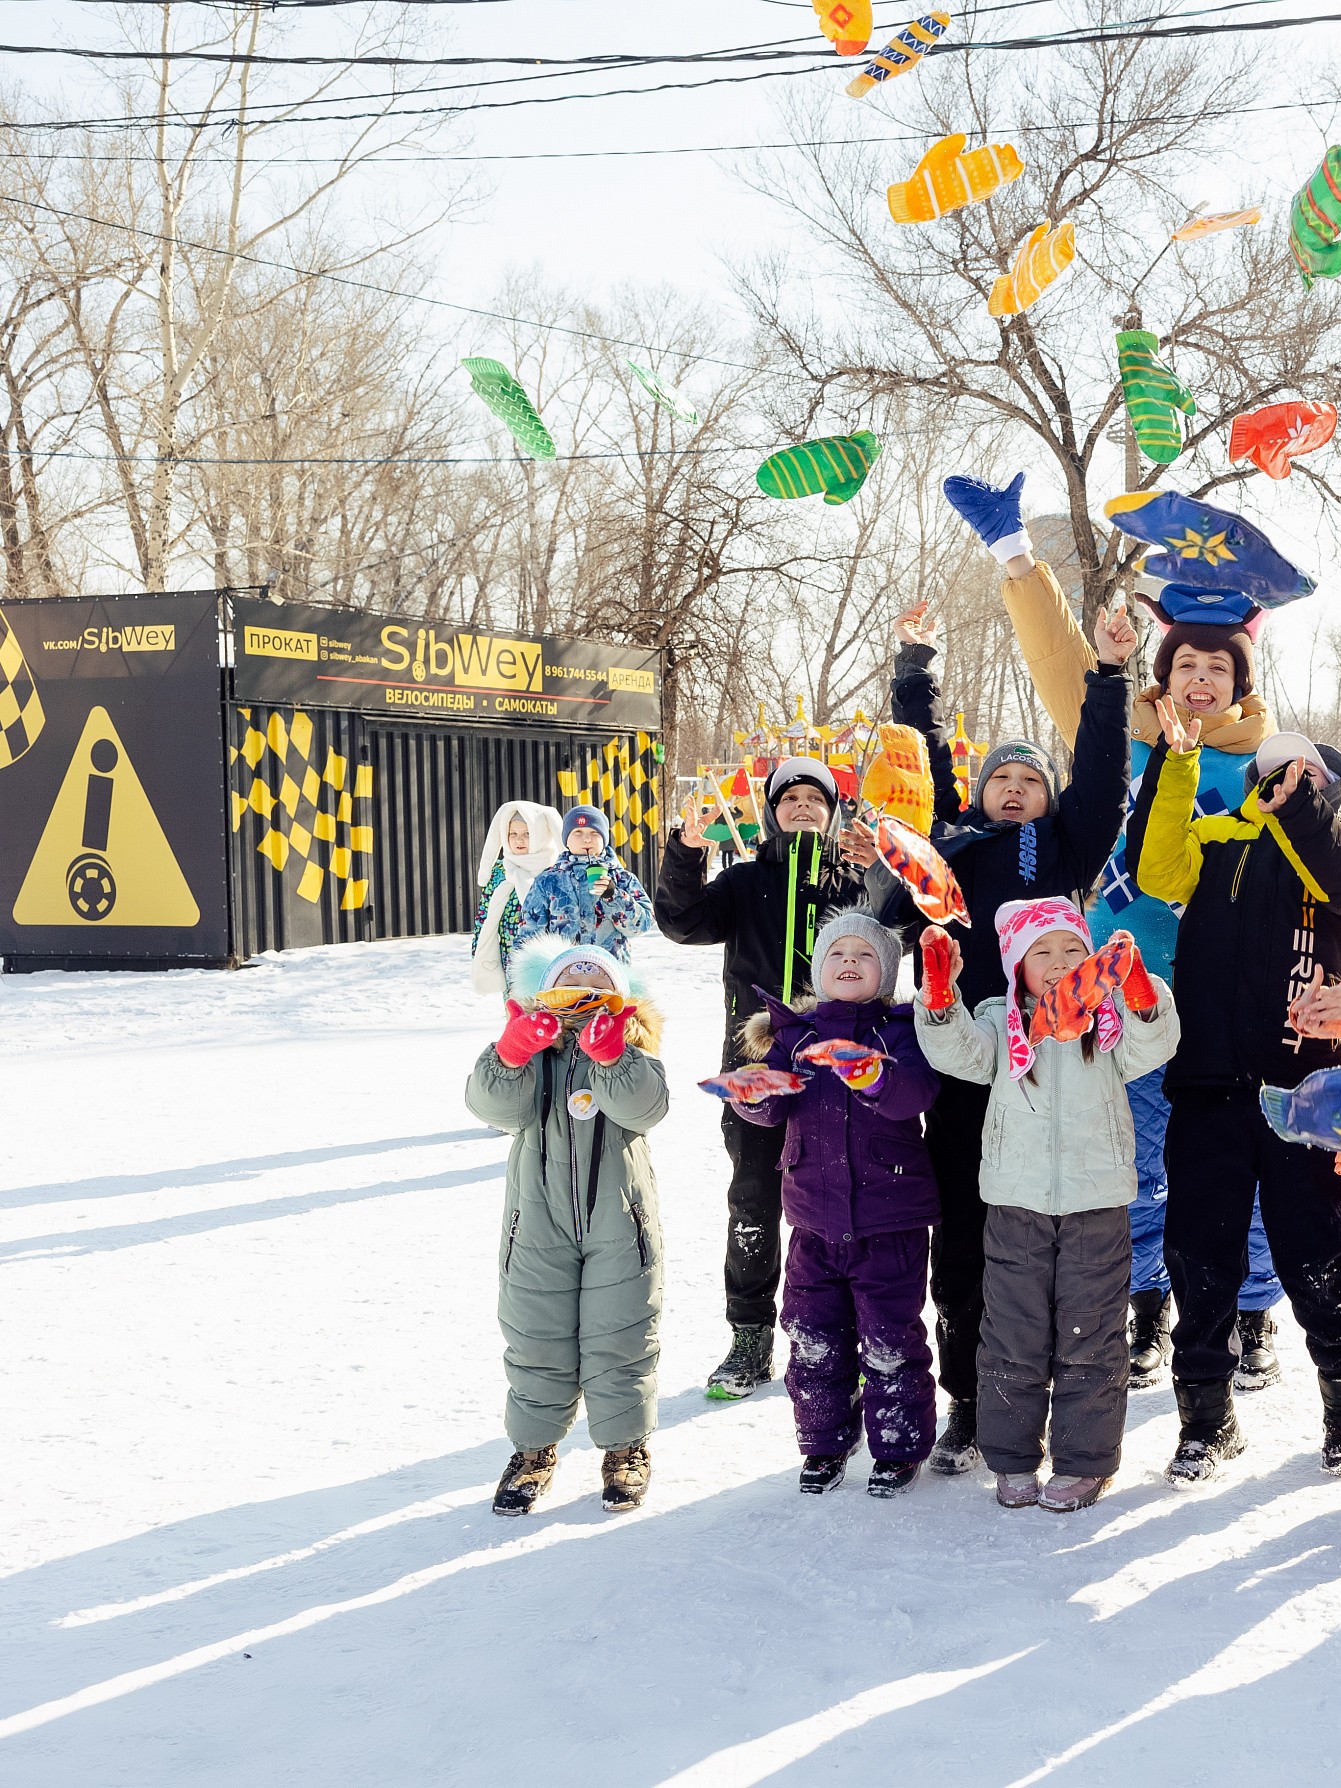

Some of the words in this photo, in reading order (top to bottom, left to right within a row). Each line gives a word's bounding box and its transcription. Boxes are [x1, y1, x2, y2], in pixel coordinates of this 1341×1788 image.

[250, 633, 313, 654] ПРОКАТ
[329, 640, 352, 651] sibwey
[330, 652, 378, 664] sibwey_abakan
[380, 625, 541, 691] SibWey
[611, 673, 652, 689] АРЕНДА
[386, 688, 474, 710] ВЕЛОСИПЕДЫ
[495, 697, 558, 715] САМОКАТЫ
